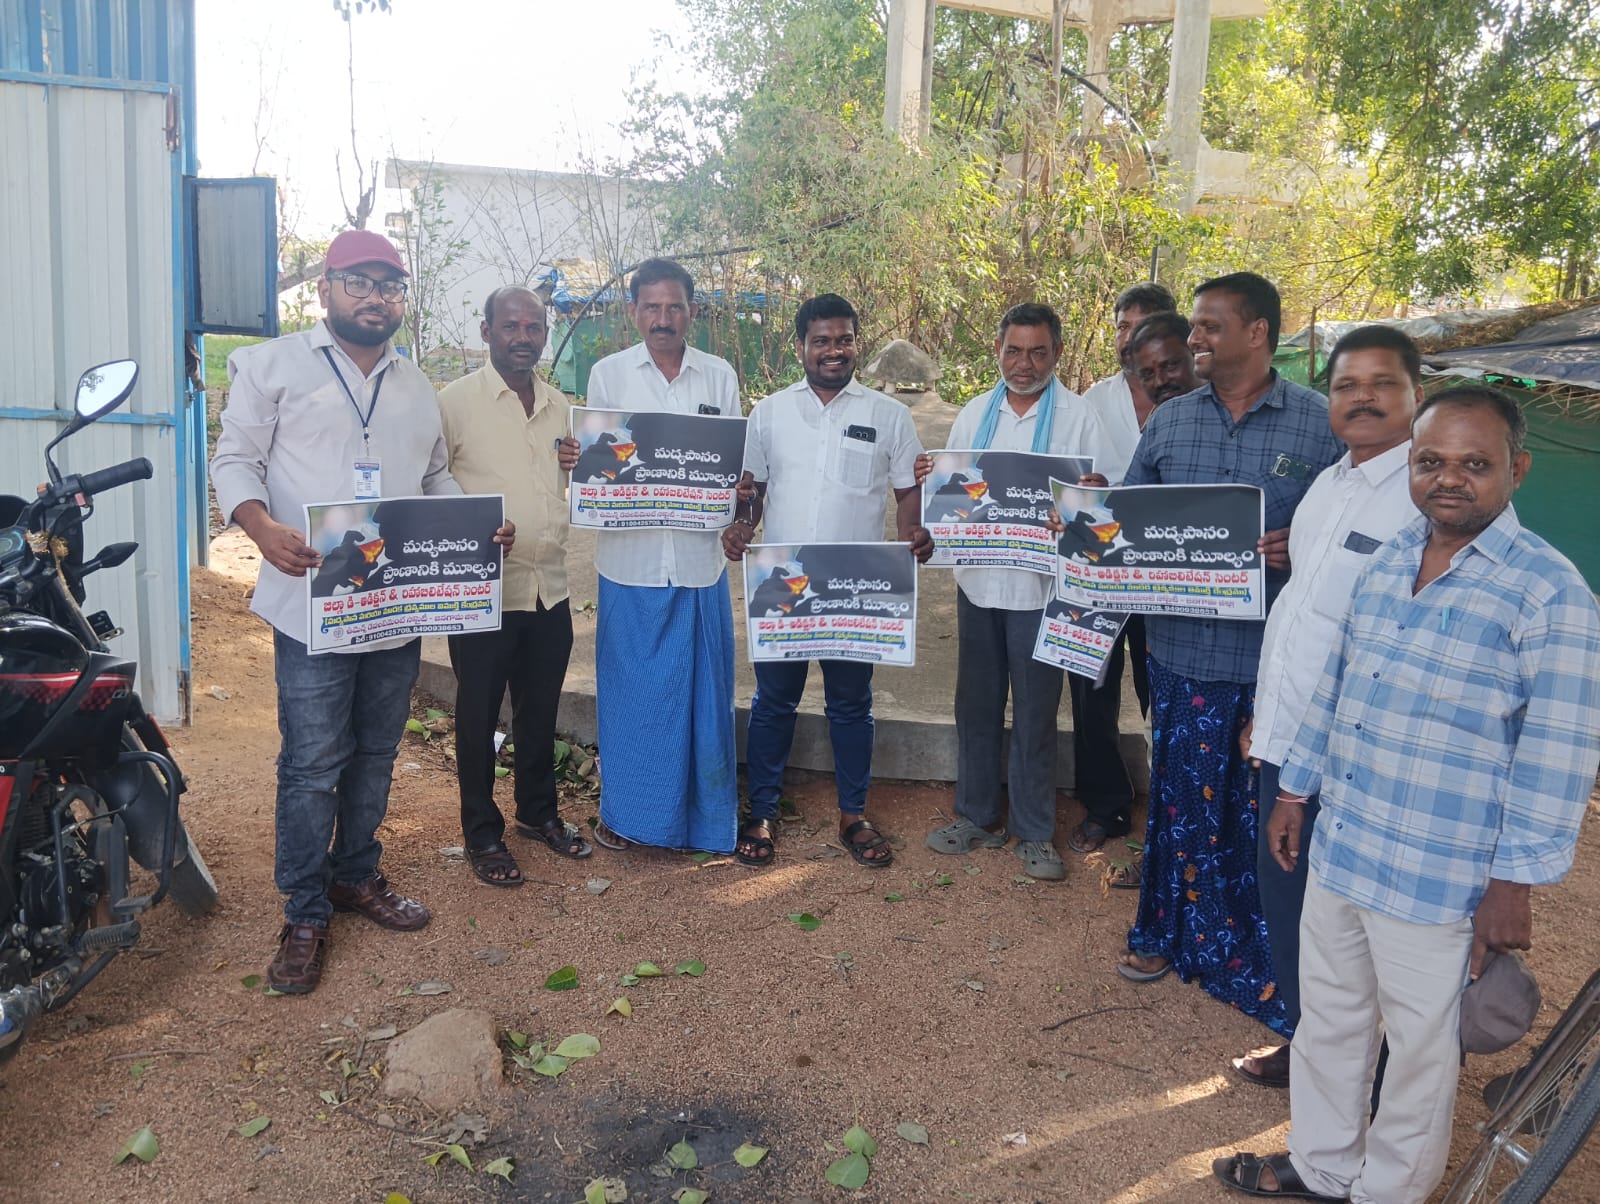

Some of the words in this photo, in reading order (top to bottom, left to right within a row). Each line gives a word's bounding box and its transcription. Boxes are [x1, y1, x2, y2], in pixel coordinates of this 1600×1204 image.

[655, 448, 721, 464] మద్యపానం
[635, 467, 686, 481] ప్రాణానికి
[689, 471, 737, 487] మూల్యం
[641, 487, 649, 496] &
[706, 489, 730, 500] సెంటర్
[1006, 487, 1054, 502] మద్యపా
[988, 508, 1036, 521] ప్రాణానికి
[1144, 526, 1228, 545] మద్యపానం
[403, 538, 479, 557] మద్యపానం
[1123, 548, 1186, 564] ప్రాణానికి
[1191, 549, 1254, 568] మూల్యం
[383, 562, 440, 583] ప్రాణానికి
[443, 561, 496, 578] మూల్యం
[1133, 569, 1143, 580] &
[1149, 569, 1213, 584] రిహాబిలిటేషన్
[1216, 571, 1248, 584] సెంటర్
[828, 579, 891, 594] మద్యపానం
[324, 599, 344, 614] జిల్లా
[389, 589, 398, 600] &
[402, 584, 460, 598] రిహాబిలిటేషన్
[464, 583, 491, 596] సెంటర్
[811, 599, 860, 614] ప్రాణానికి
[863, 600, 909, 615] మూల్యం
[1093, 615, 1120, 630] ప్రాణా
